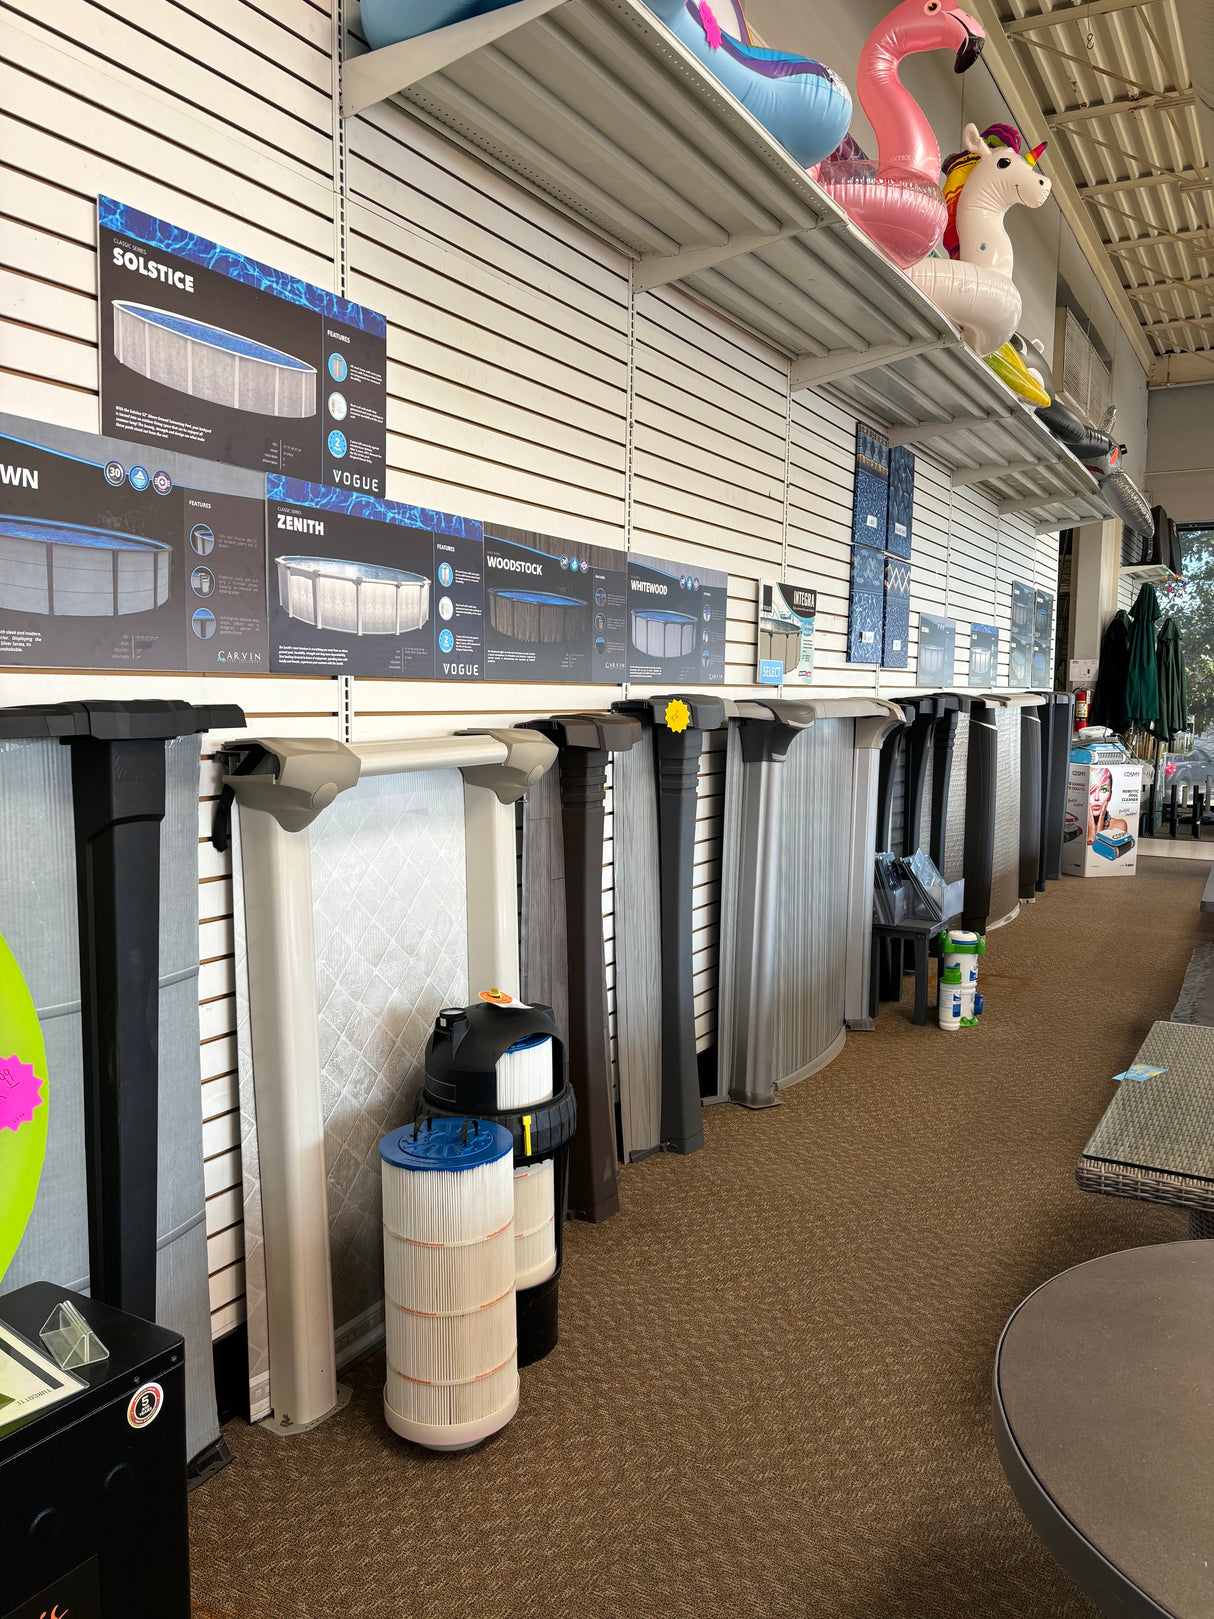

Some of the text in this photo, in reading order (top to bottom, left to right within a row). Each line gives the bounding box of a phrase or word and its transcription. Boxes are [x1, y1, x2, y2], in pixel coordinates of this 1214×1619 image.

[112, 237, 147, 255] CLASSIC SERIES
[112, 247, 194, 293] SOLSTICE
[327, 329, 350, 344] FEATURES
[334, 437, 341, 448] 2
[0, 463, 39, 490] WN
[109, 466, 121, 478] 30
[333, 469, 379, 492] VOGUE
[188, 499, 212, 509] FEATURES
[277, 513, 325, 536] ZENITH
[486, 555, 543, 576] WOODSTOCK
[630, 579, 668, 595] WHITEWOOD
[793, 590, 815, 607] INTEGRA
[217, 650, 261, 662] CARVIN
[443, 663, 479, 675] VOGUE
[605, 661, 625, 669] CARVIN
[762, 665, 781, 679] SELECT
[16, 1388, 51, 1406] TURCOTTE
[141, 1395, 150, 1407] 5
